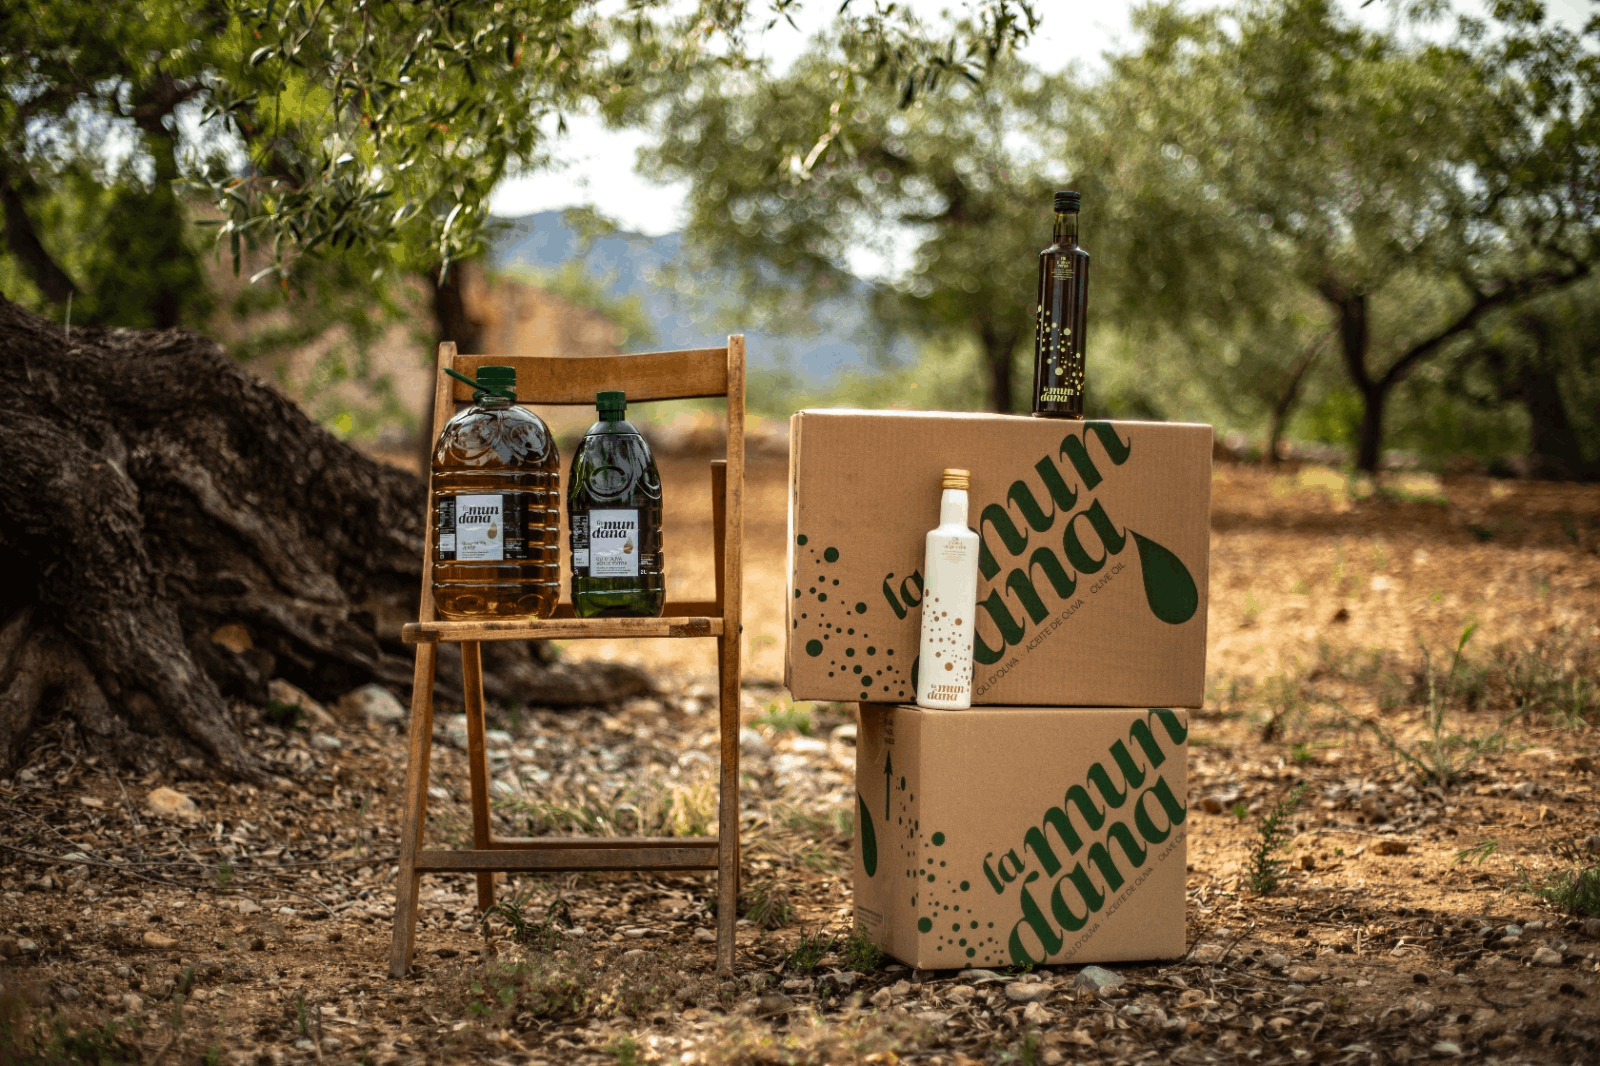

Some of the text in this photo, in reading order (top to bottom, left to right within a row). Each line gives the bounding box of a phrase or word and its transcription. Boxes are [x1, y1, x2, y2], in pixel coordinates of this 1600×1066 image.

[1041, 392, 1068, 402] dana
[1049, 387, 1074, 395] mun
[469, 506, 499, 515] mun
[458, 512, 491, 524] dana
[603, 521, 635, 529] mun
[592, 526, 628, 538] dana
[976, 562, 1126, 696] OLI D'OLIVA ACEITE DE OLIVA OLIVE OIL
[983, 709, 1188, 895] la mun
[1008, 775, 1187, 965] dana
[1064, 946, 1077, 960] OLI
[1105, 893, 1127, 918] ACEITE
[1125, 885, 1137, 896] DE
[1134, 867, 1153, 886] OLIVA
[1157, 842, 1177, 861] OLIVE
